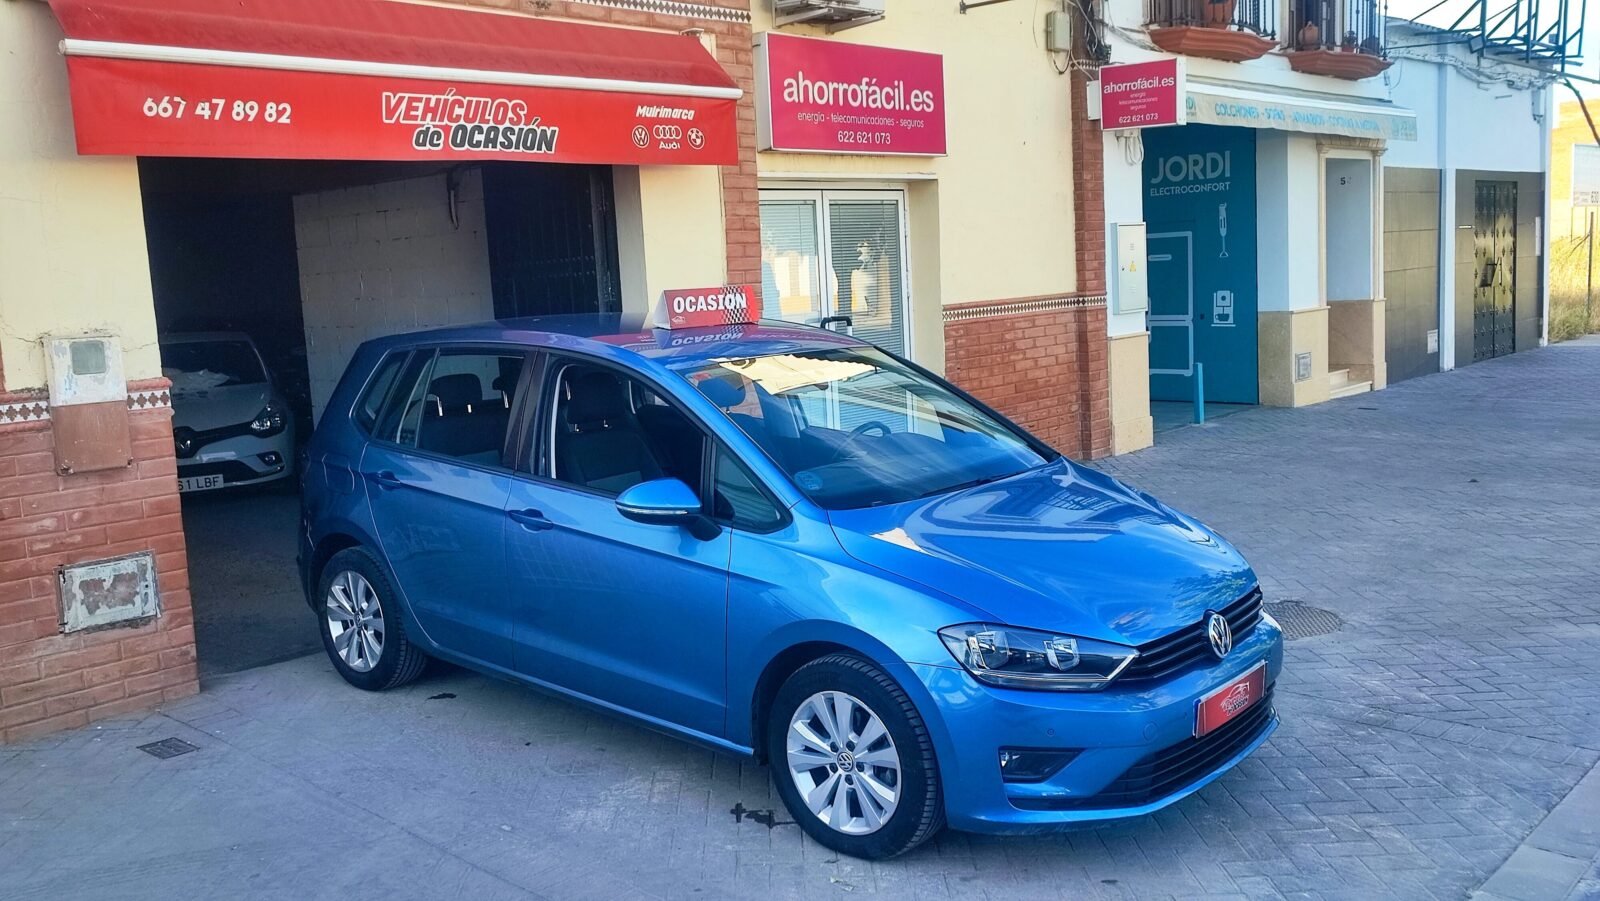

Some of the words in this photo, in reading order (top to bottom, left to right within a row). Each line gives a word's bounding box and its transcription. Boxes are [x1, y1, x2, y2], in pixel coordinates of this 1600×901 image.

[783, 71, 935, 112] ahorrofácil.es
[1104, 76, 1175, 94] ahorrofácil.es
[143, 96, 187, 119] 667
[194, 98, 226, 121] 47
[232, 100, 259, 122] 89
[264, 102, 292, 124] 82
[382, 88, 527, 126] VEHÍCULOS
[899, 118, 925, 130] seguros
[1118, 115, 1131, 124] 622
[1132, 114, 1144, 122] 621
[1145, 113, 1159, 121] 073
[412, 125, 444, 150] de
[449, 116, 559, 154] OCASIÓN
[837, 130, 855, 143] 622
[856, 131, 872, 144] 621
[874, 132, 891, 145] 073
[1150, 150, 1231, 184] JORDI
[1150, 182, 1231, 197] ELECTROCONFORT
[196, 476, 220, 489] LBF
